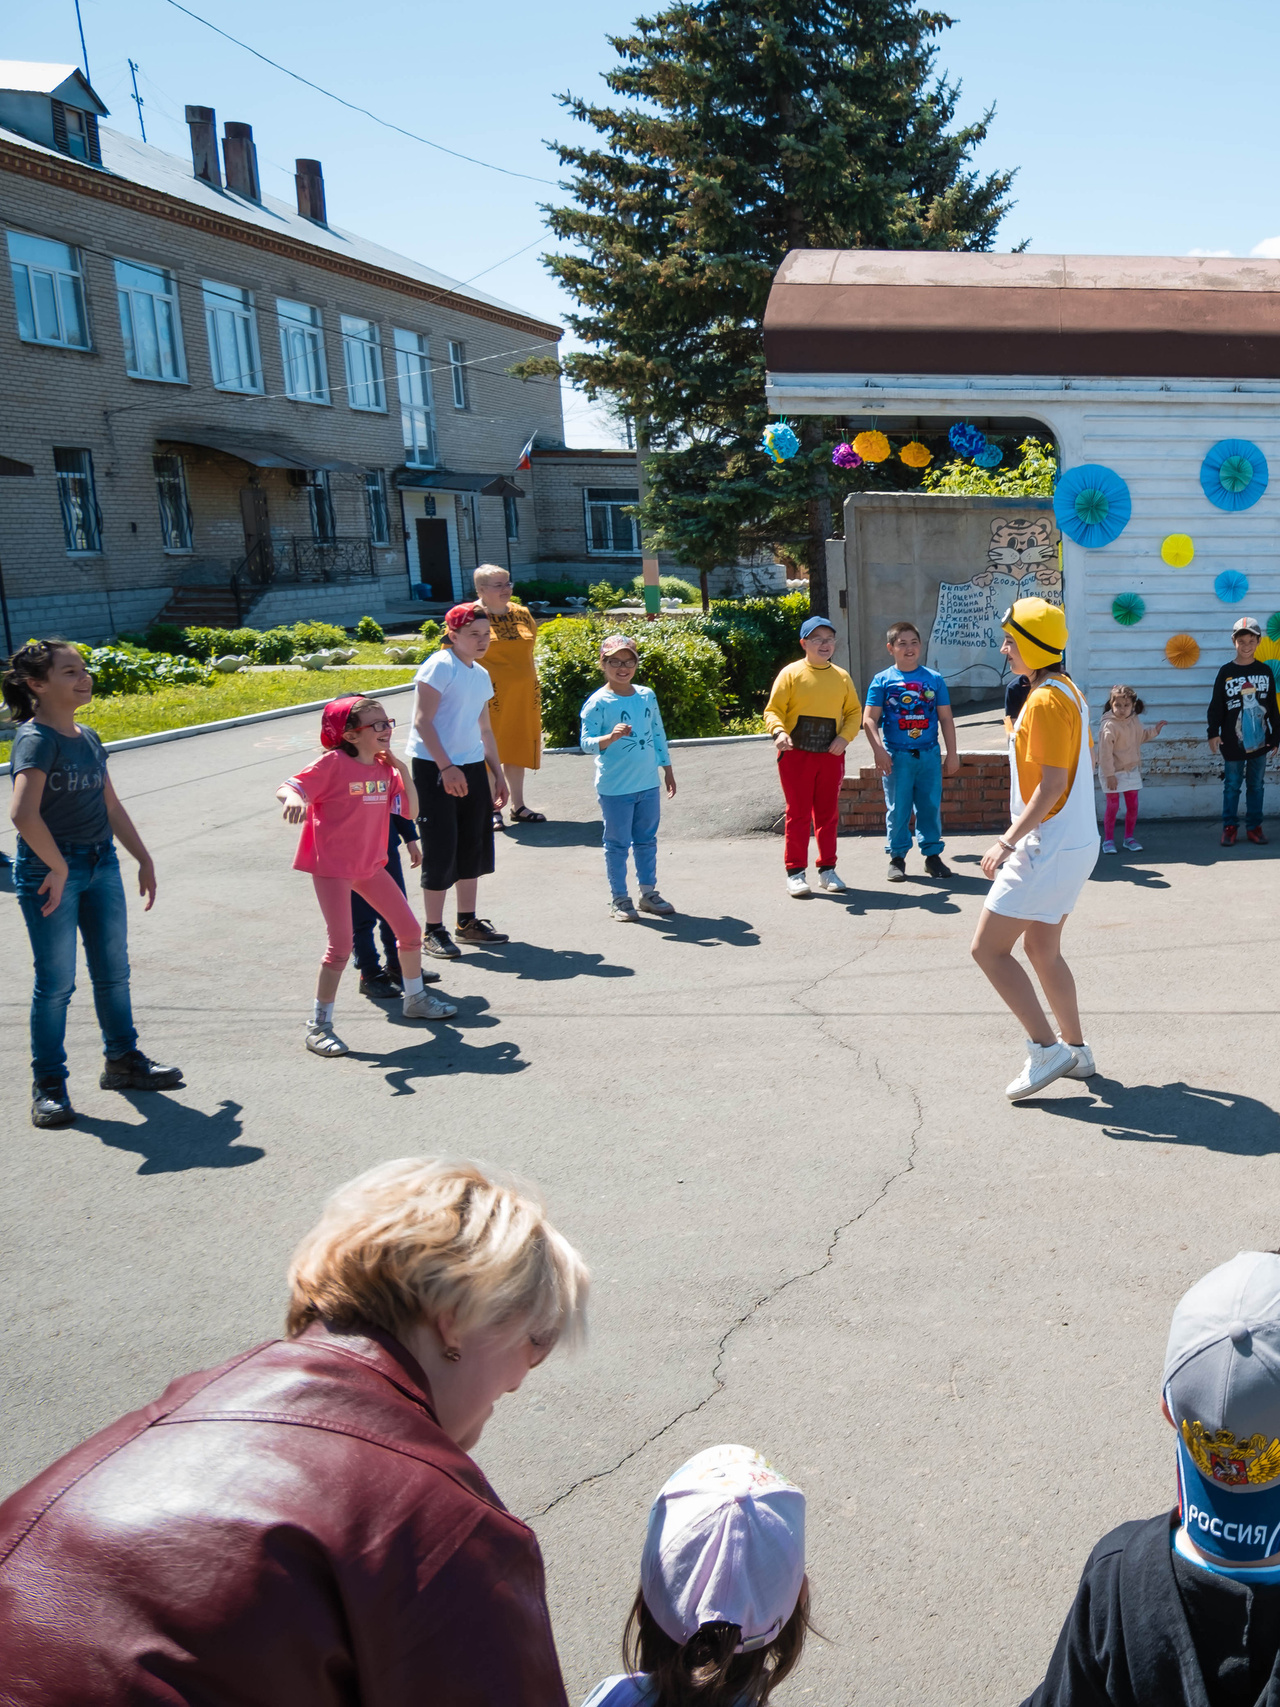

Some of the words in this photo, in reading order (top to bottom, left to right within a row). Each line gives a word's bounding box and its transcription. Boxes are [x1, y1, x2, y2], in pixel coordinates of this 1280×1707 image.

[1247, 675, 1270, 684] WAY
[898, 718, 929, 730] STARS
[1188, 1504, 1268, 1546] РОССИЯ
